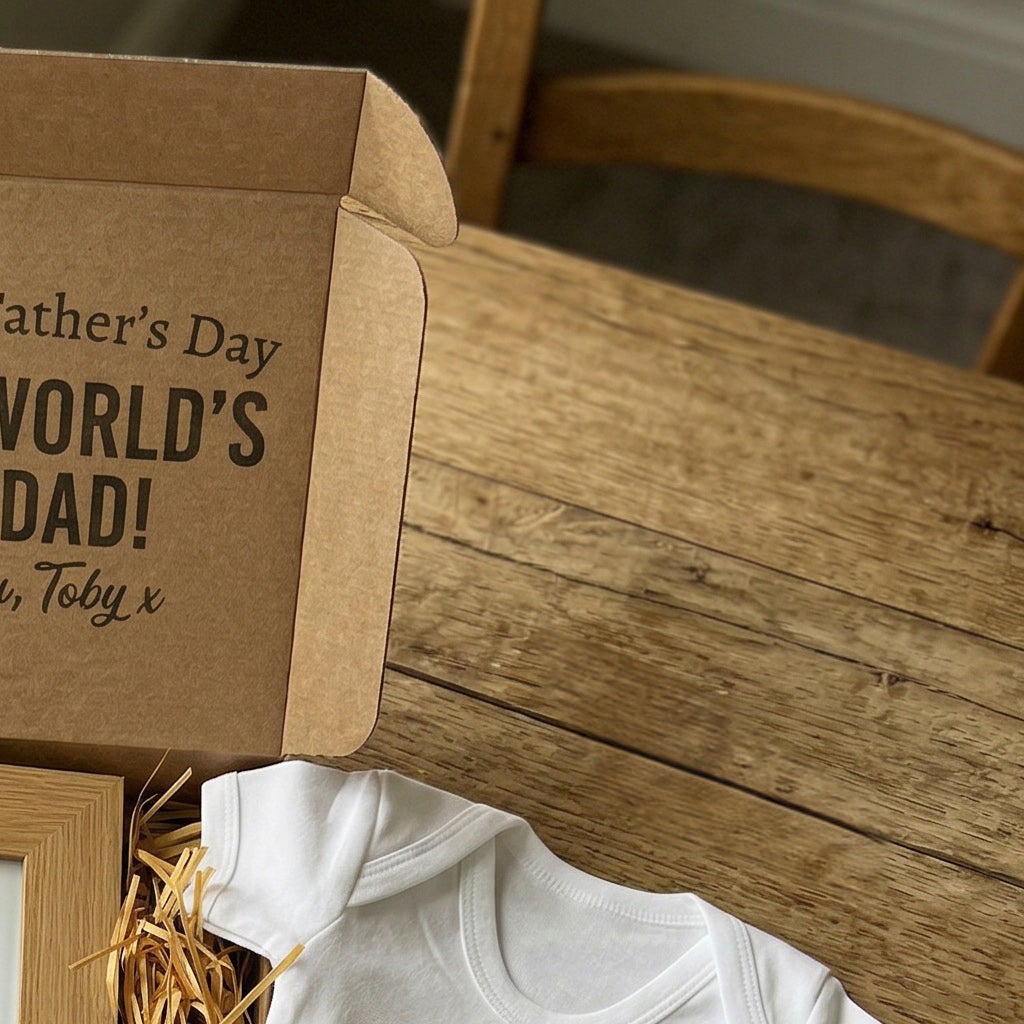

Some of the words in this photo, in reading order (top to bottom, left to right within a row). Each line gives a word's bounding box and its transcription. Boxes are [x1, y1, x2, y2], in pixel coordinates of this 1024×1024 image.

[183, 313, 282, 380] Day
[0, 469, 152, 550] DAD!
[34, 561, 133, 628] Toby
[136, 582, 165, 615] x
